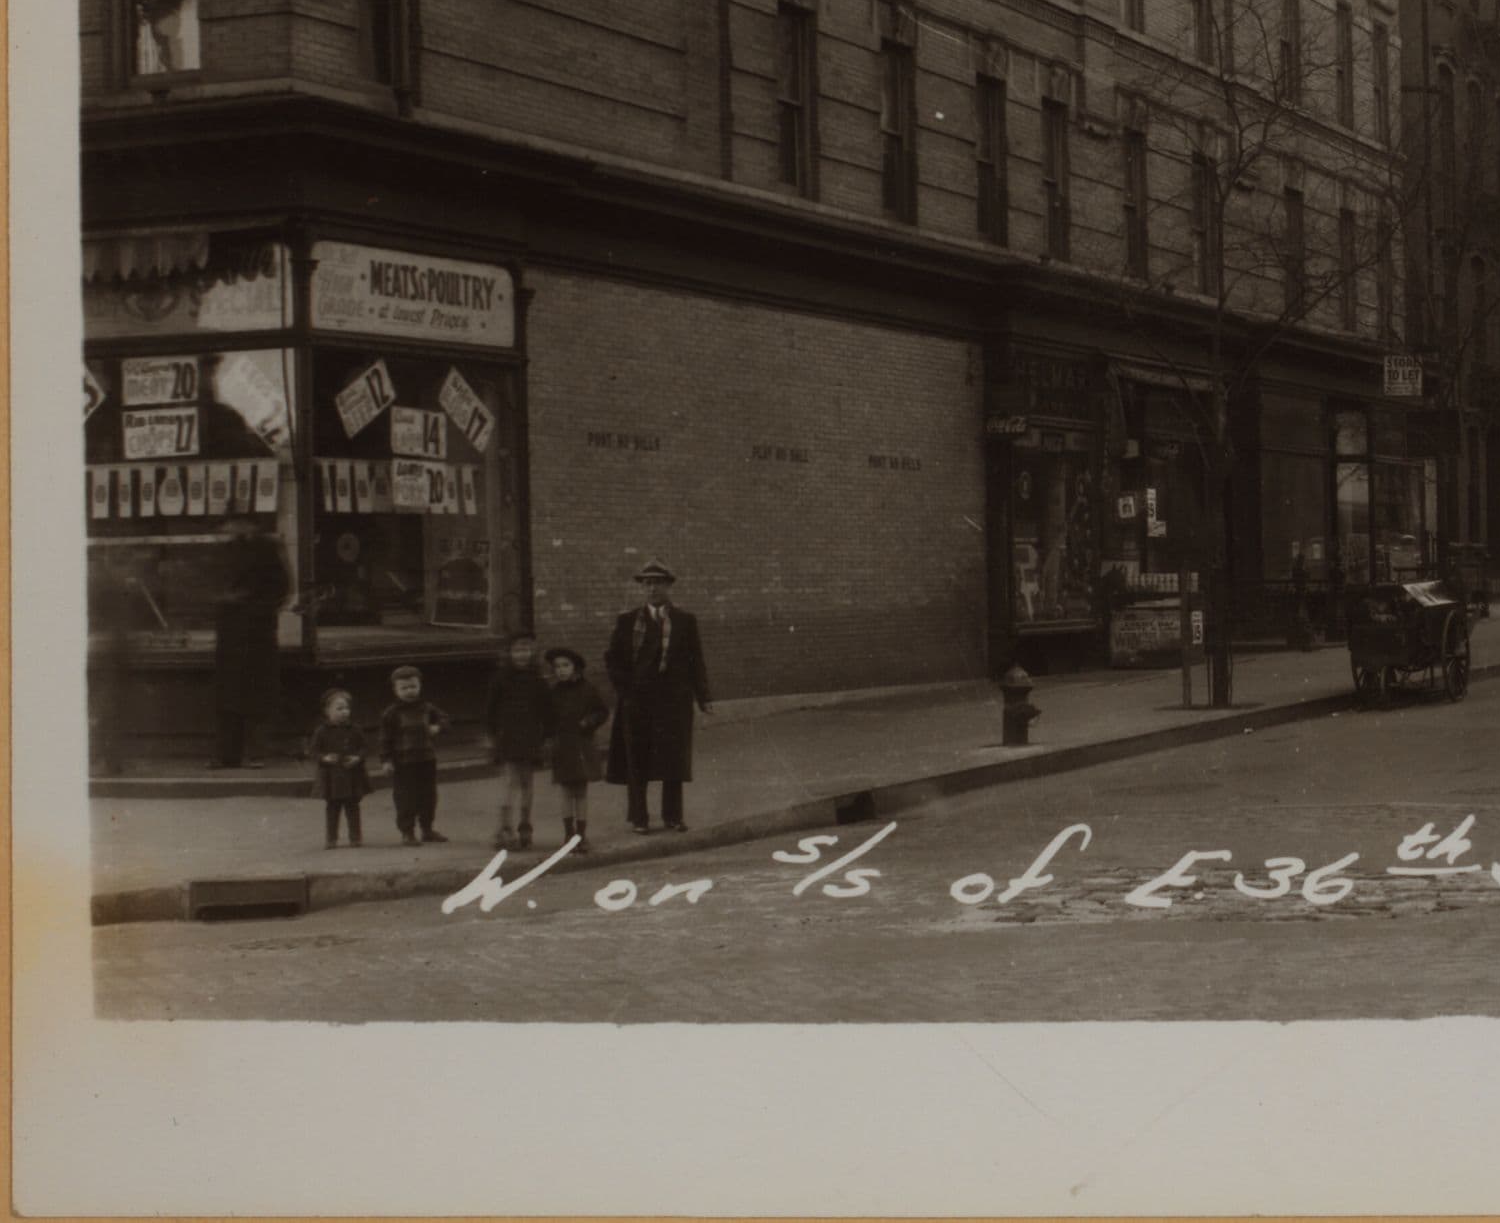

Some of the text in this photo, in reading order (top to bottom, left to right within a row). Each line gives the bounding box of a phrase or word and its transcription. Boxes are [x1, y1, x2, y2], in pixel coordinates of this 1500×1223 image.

[370, 260, 418, 301] MEATS
[427, 268, 496, 311] POULTRY
[171, 362, 195, 400] 20
[366, 368, 391, 410] 12
[1387, 369, 1420, 380] TO LET
[423, 412, 441, 455] 14
